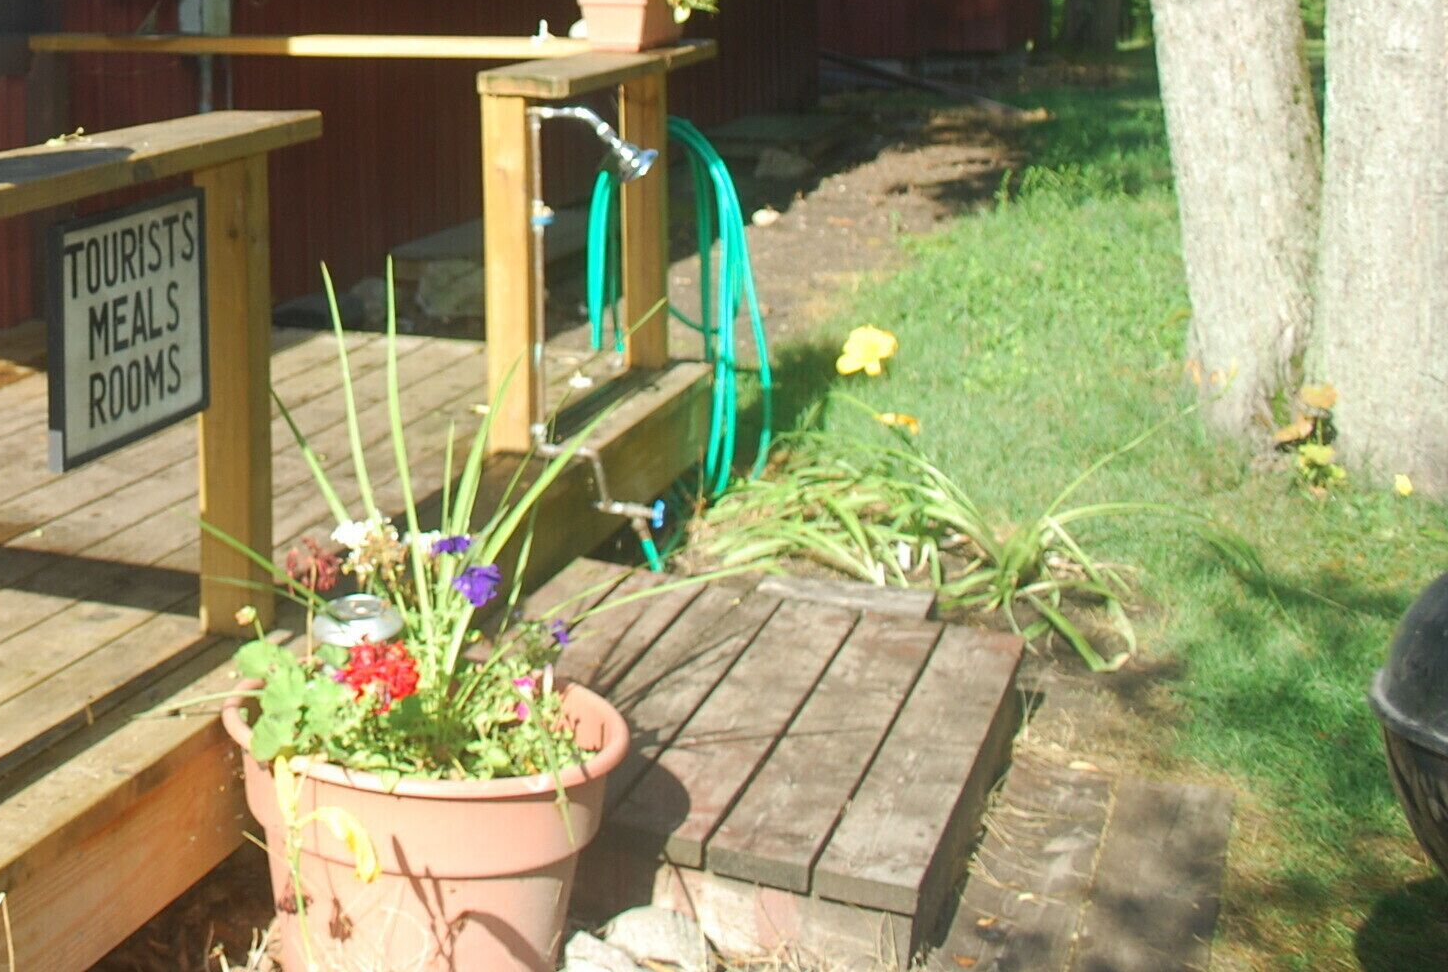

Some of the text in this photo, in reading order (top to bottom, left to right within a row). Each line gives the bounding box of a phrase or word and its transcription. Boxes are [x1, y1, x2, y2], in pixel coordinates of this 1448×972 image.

[64, 211, 195, 299] TOURISTS
[89, 281, 180, 360] MEALS
[89, 344, 181, 428] ROOMS
